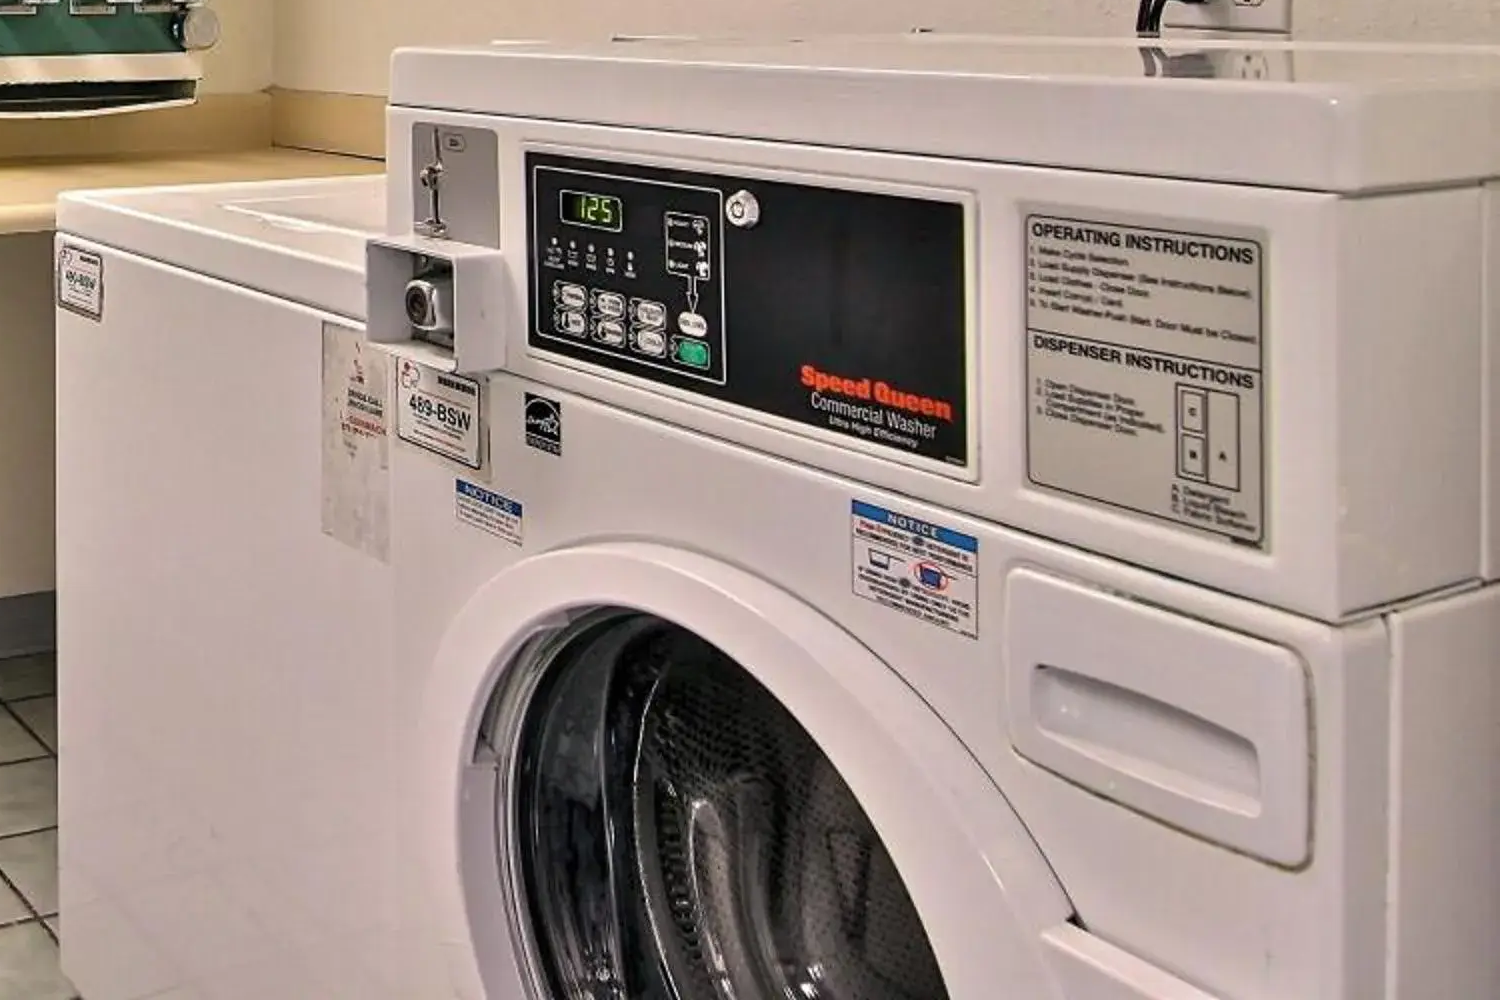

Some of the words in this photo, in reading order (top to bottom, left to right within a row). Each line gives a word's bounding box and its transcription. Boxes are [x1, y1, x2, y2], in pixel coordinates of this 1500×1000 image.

[580, 197, 612, 224] 125
[1031, 222, 1121, 249] OPERATING
[1125, 234, 1254, 265] INSTRUCTIONS
[1033, 335, 1121, 365] DISPENSER
[1125, 352, 1255, 389] INSTRUCTIONS
[800, 364, 871, 399] Speed
[873, 381, 952, 421] Queen
[810, 391, 884, 426] Commercial
[886, 411, 938, 440] Washer
[1217, 450, 1228, 462] A
[887, 512, 938, 538] NOTICE
